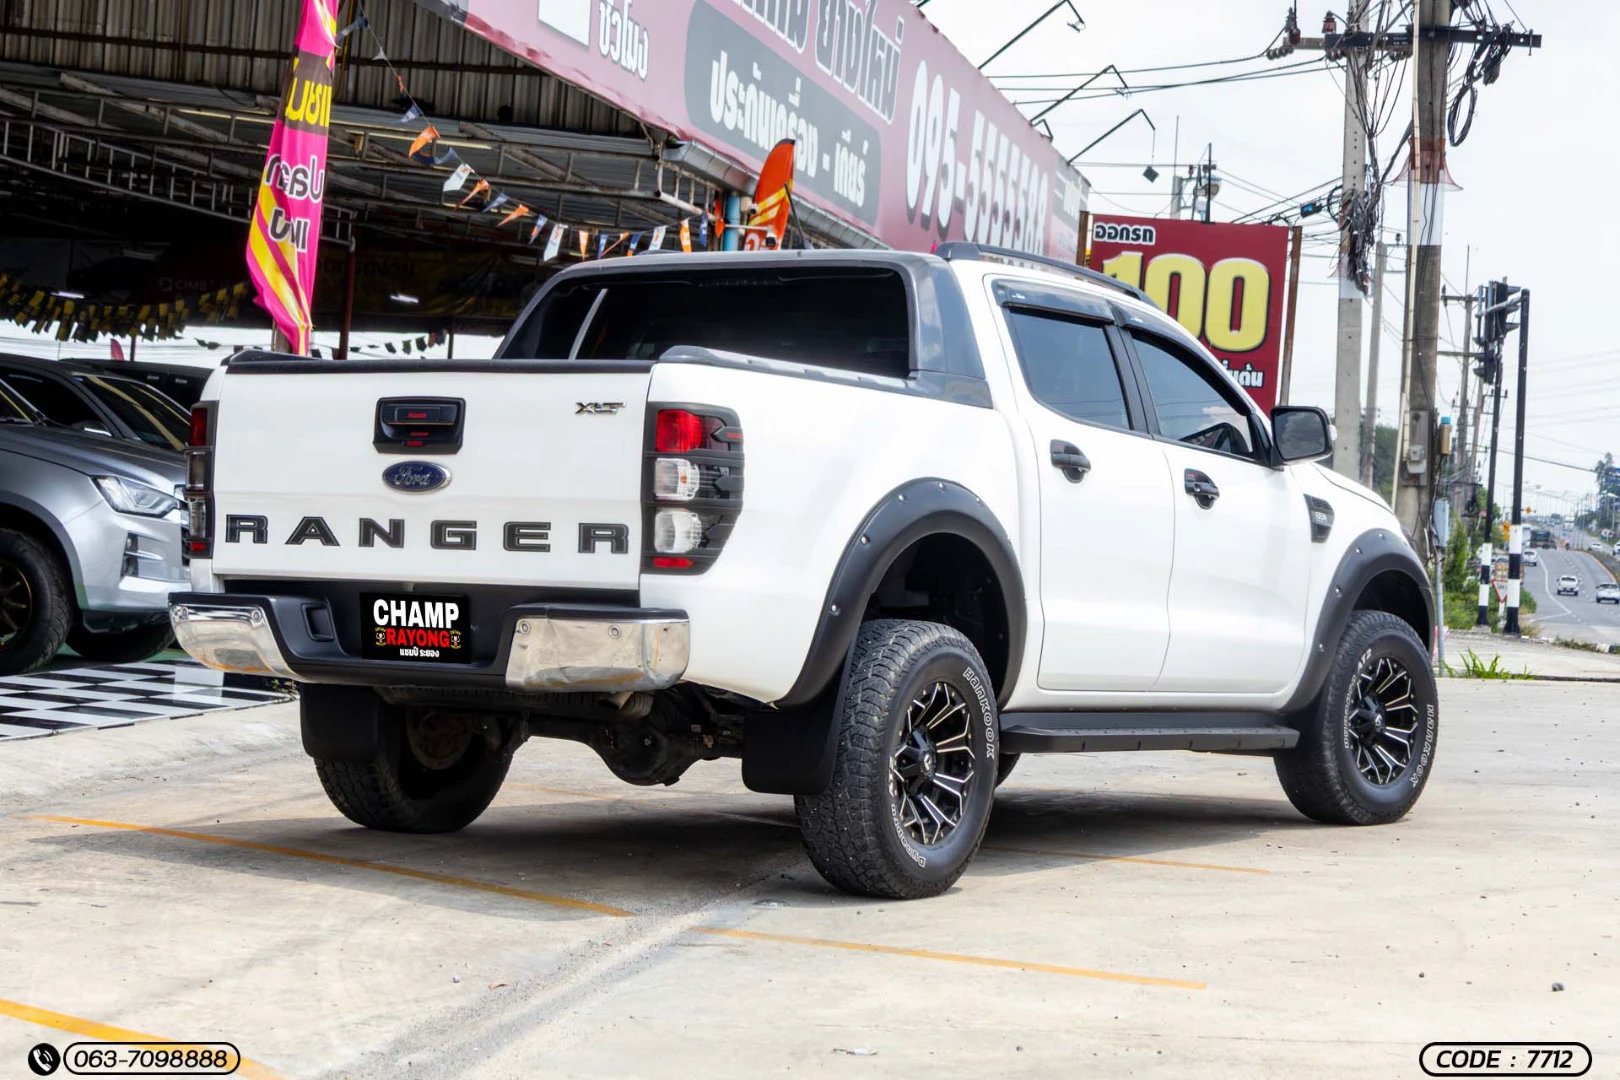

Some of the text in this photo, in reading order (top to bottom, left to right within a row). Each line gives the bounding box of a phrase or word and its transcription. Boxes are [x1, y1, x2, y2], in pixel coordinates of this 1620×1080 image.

[906, 59, 1049, 258] 095-5555588
[574, 401, 627, 415] XLT
[393, 465, 432, 486] Ford
[225, 513, 630, 555] RANGER
[373, 598, 460, 629] CHAMP
[386, 627, 450, 648] RAYONG
